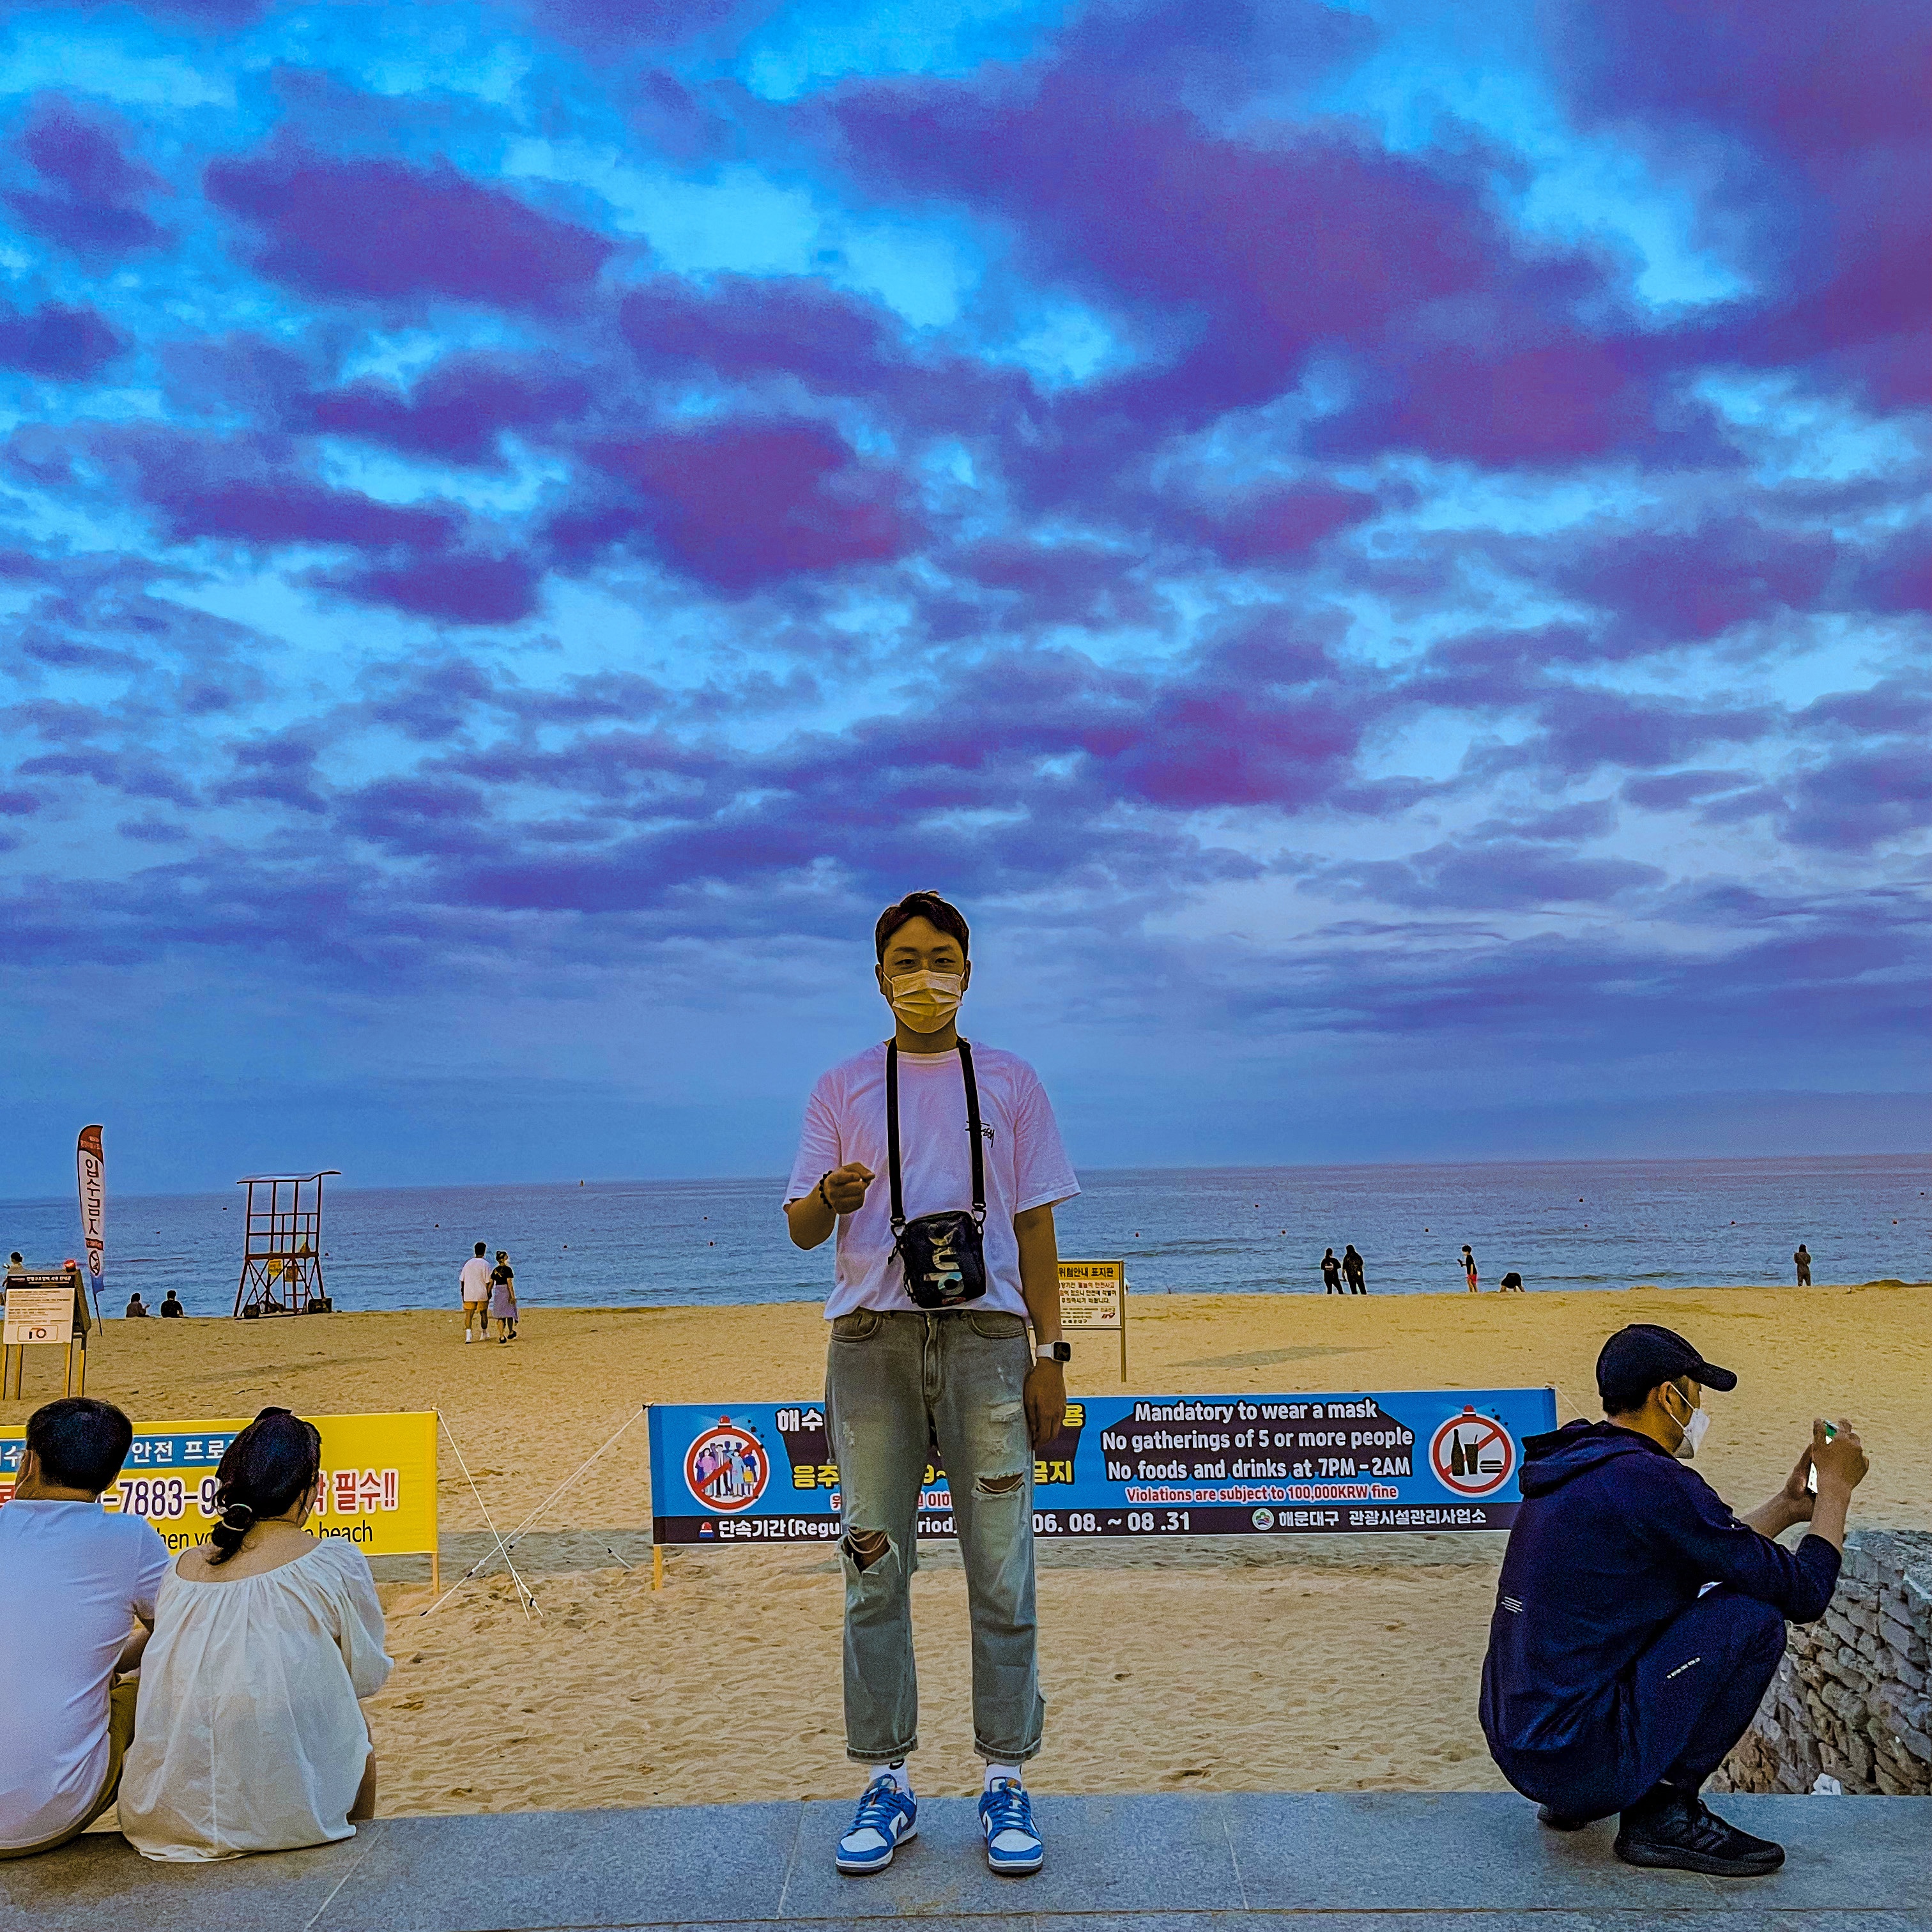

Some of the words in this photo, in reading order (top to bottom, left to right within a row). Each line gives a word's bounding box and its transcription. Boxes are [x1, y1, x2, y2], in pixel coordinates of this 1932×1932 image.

[777, 1409, 823, 1432] 해수
[1135, 1402, 1234, 1423] Mandatory
[1238, 1402, 1257, 1420] to
[1262, 1404, 1308, 1420] wear
[1312, 1404, 1324, 1419] a
[1328, 1399, 1378, 1418] mask
[132, 1441, 173, 1463] 안전
[183, 1439, 234, 1460] 프로
[1103, 1432, 1127, 1450] No
[1131, 1430, 1230, 1453] gatherings
[1234, 1429, 1255, 1448] of
[1259, 1429, 1269, 1447] 5
[1274, 1432, 1294, 1446] or
[1298, 1431, 1346, 1446] more
[1351, 1427, 1413, 1449] people
[793, 1465, 840, 1488] 음주
[1108, 1461, 1131, 1479] No
[1137, 1460, 1188, 1479] foods
[1193, 1459, 1225, 1478] and
[1232, 1458, 1287, 1478] drinks
[1292, 1459, 1313, 1477] at
[1318, 1458, 1356, 1476] 7PM
[1372, 1457, 1411, 1476] 2AM
[97, 1479, 216, 1515] -7883-9
[335, 1472, 395, 1511] 필수!!
[1126, 1486, 1192, 1502] Violations
[1195, 1489, 1216, 1499] are
[1220, 1485, 1268, 1503] subject
[1271, 1487, 1284, 1499] to
[1288, 1485, 1368, 1501] 100,000KRW
[1372, 1483, 1397, 1498] fine
[719, 1518, 843, 1538] 단속기간(Regu
[917, 1516, 958, 1534] riod
[1032, 1514, 1064, 1533] 06.
[1069, 1513, 1102, 1532] 08.
[1128, 1512, 1154, 1531] 08
[1278, 1510, 1340, 1527] 해운대구
[1349, 1508, 1487, 1526] 관광시설관리사업소
[157, 1527, 189, 1550] hen
[319, 1520, 373, 1543] beach
